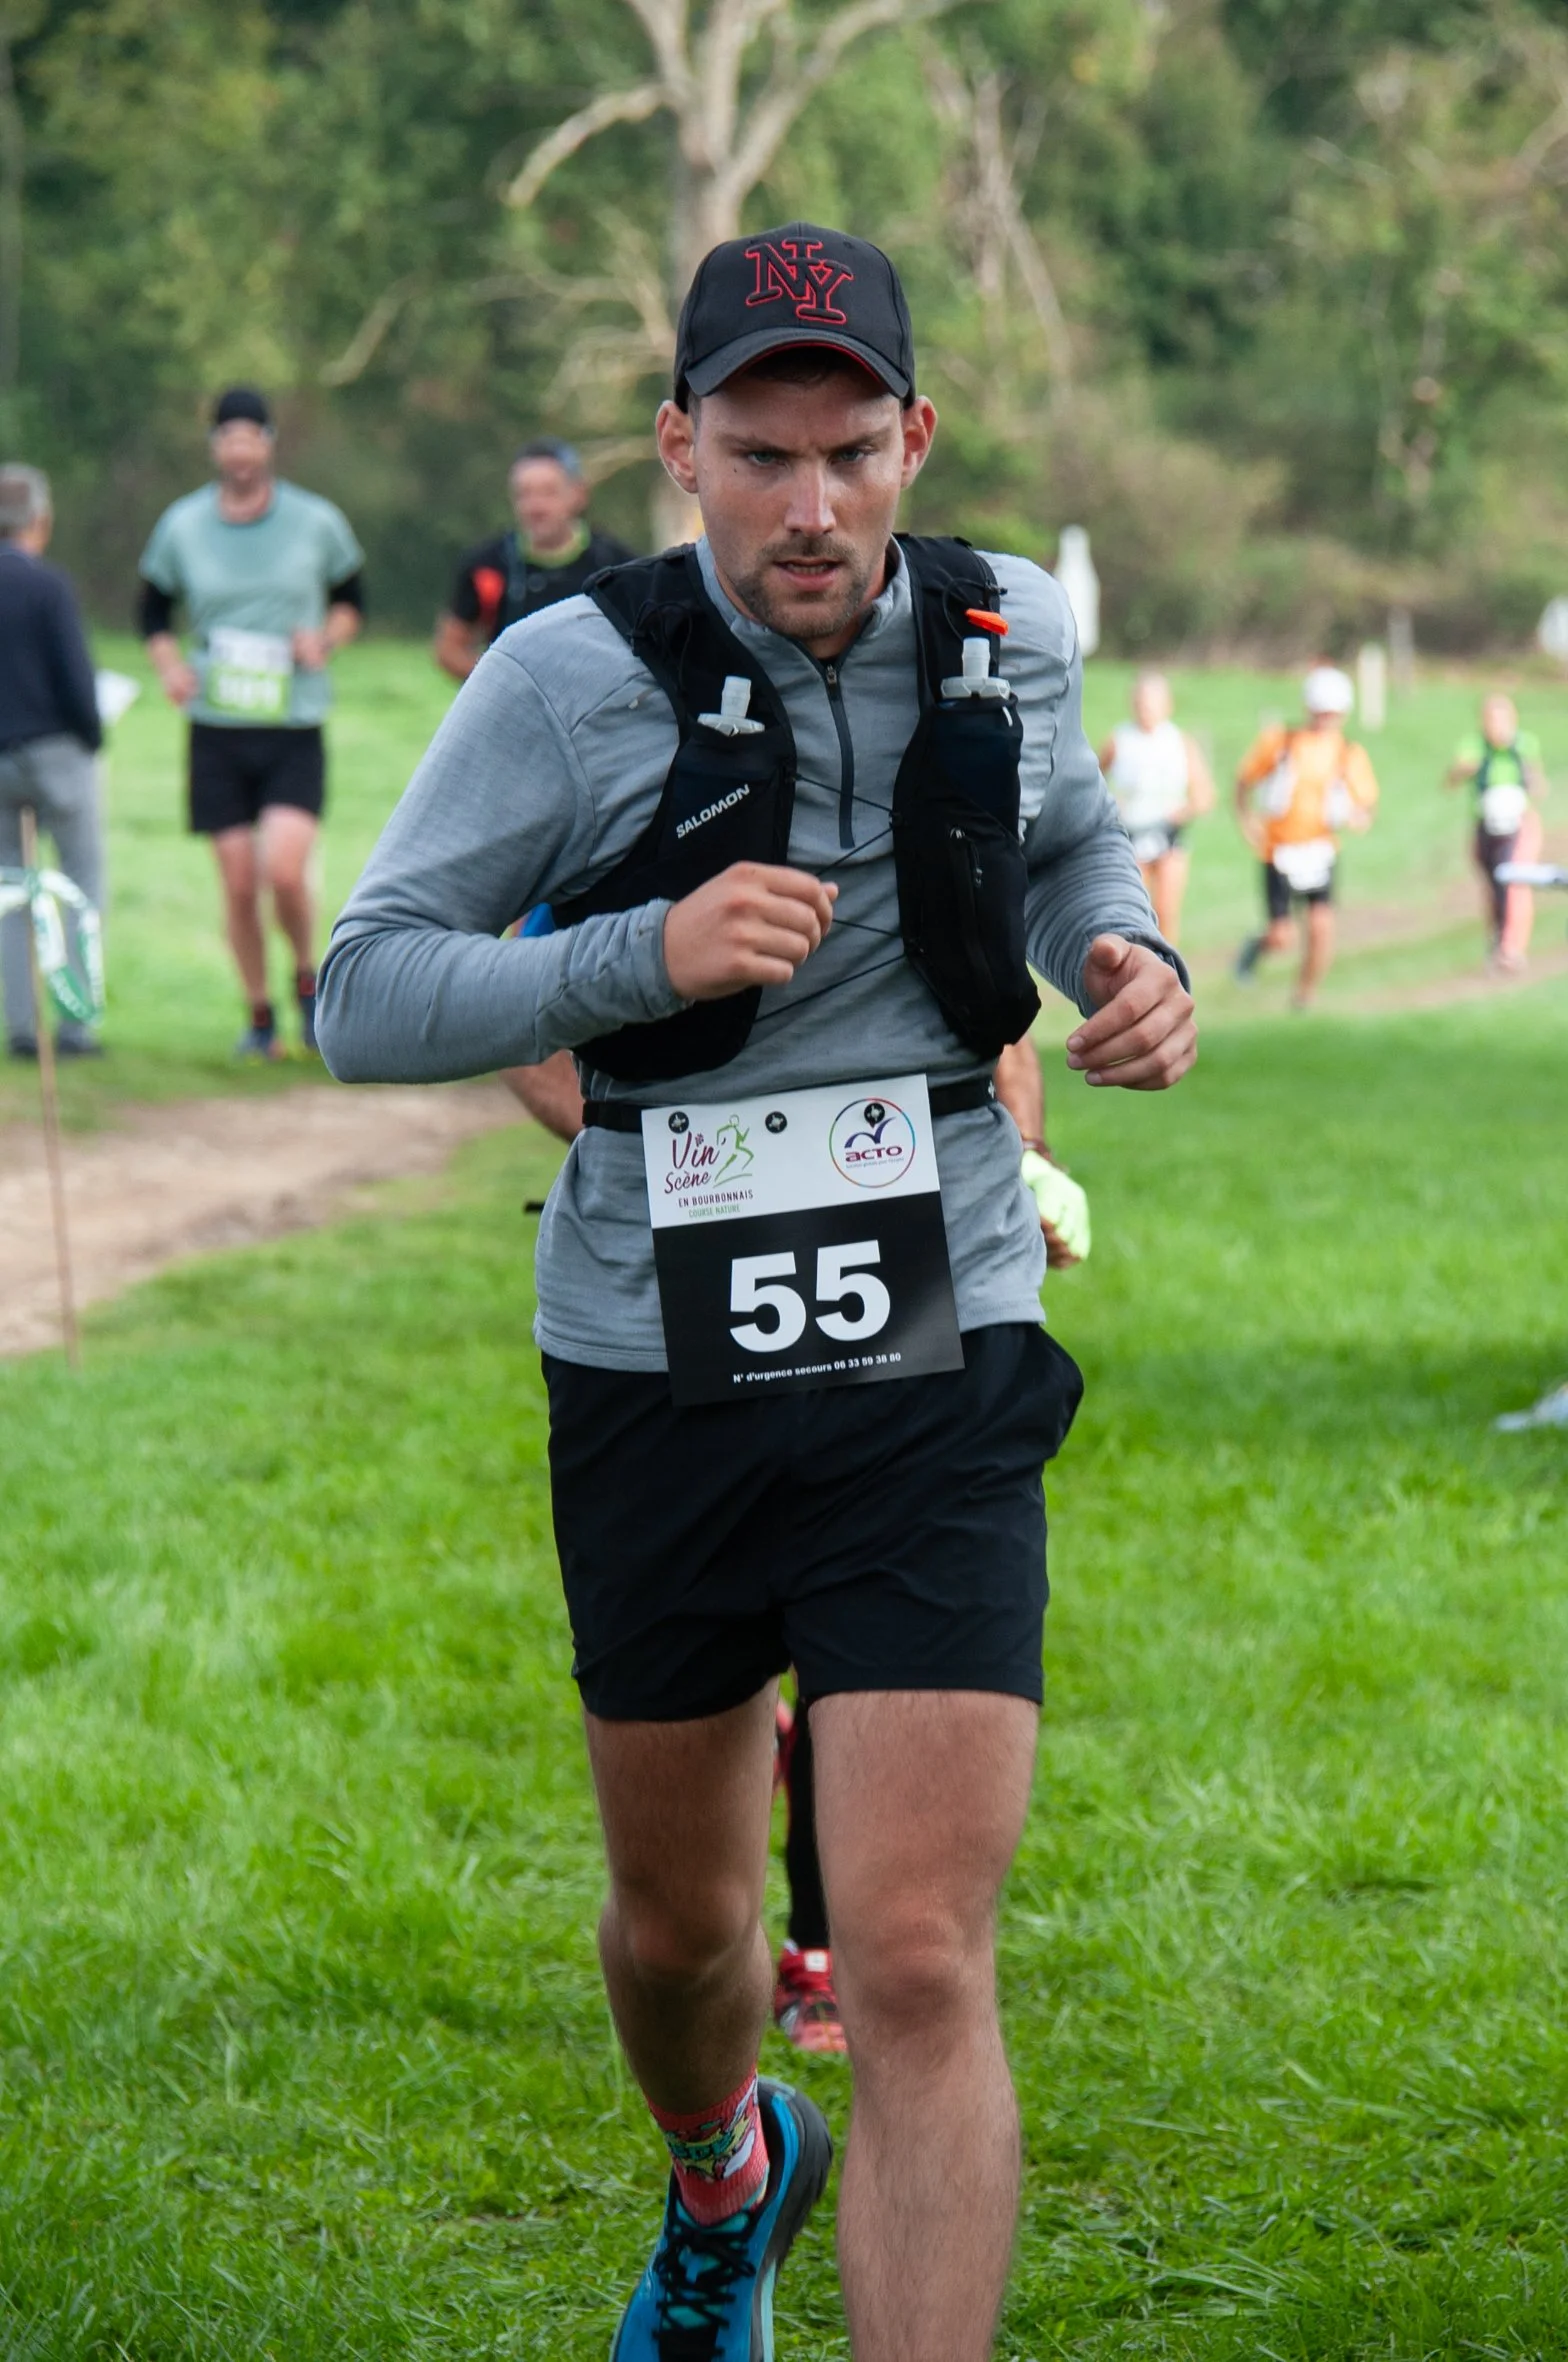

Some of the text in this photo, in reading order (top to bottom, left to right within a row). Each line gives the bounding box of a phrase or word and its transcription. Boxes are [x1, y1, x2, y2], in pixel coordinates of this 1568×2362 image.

[744, 237, 854, 324] NY
[675, 783, 750, 839] SALOMON
[664, 1171, 711, 1194] Scène
[679, 1189, 754, 1208] EN BOURBONNAIS
[688, 1204, 740, 1218] COURSE NATURE
[729, 1240, 890, 1352] 55
[746, 1369, 793, 1382] d'urgence
[795, 1363, 832, 1376] secours
[848, 1358, 860, 1369] 33
